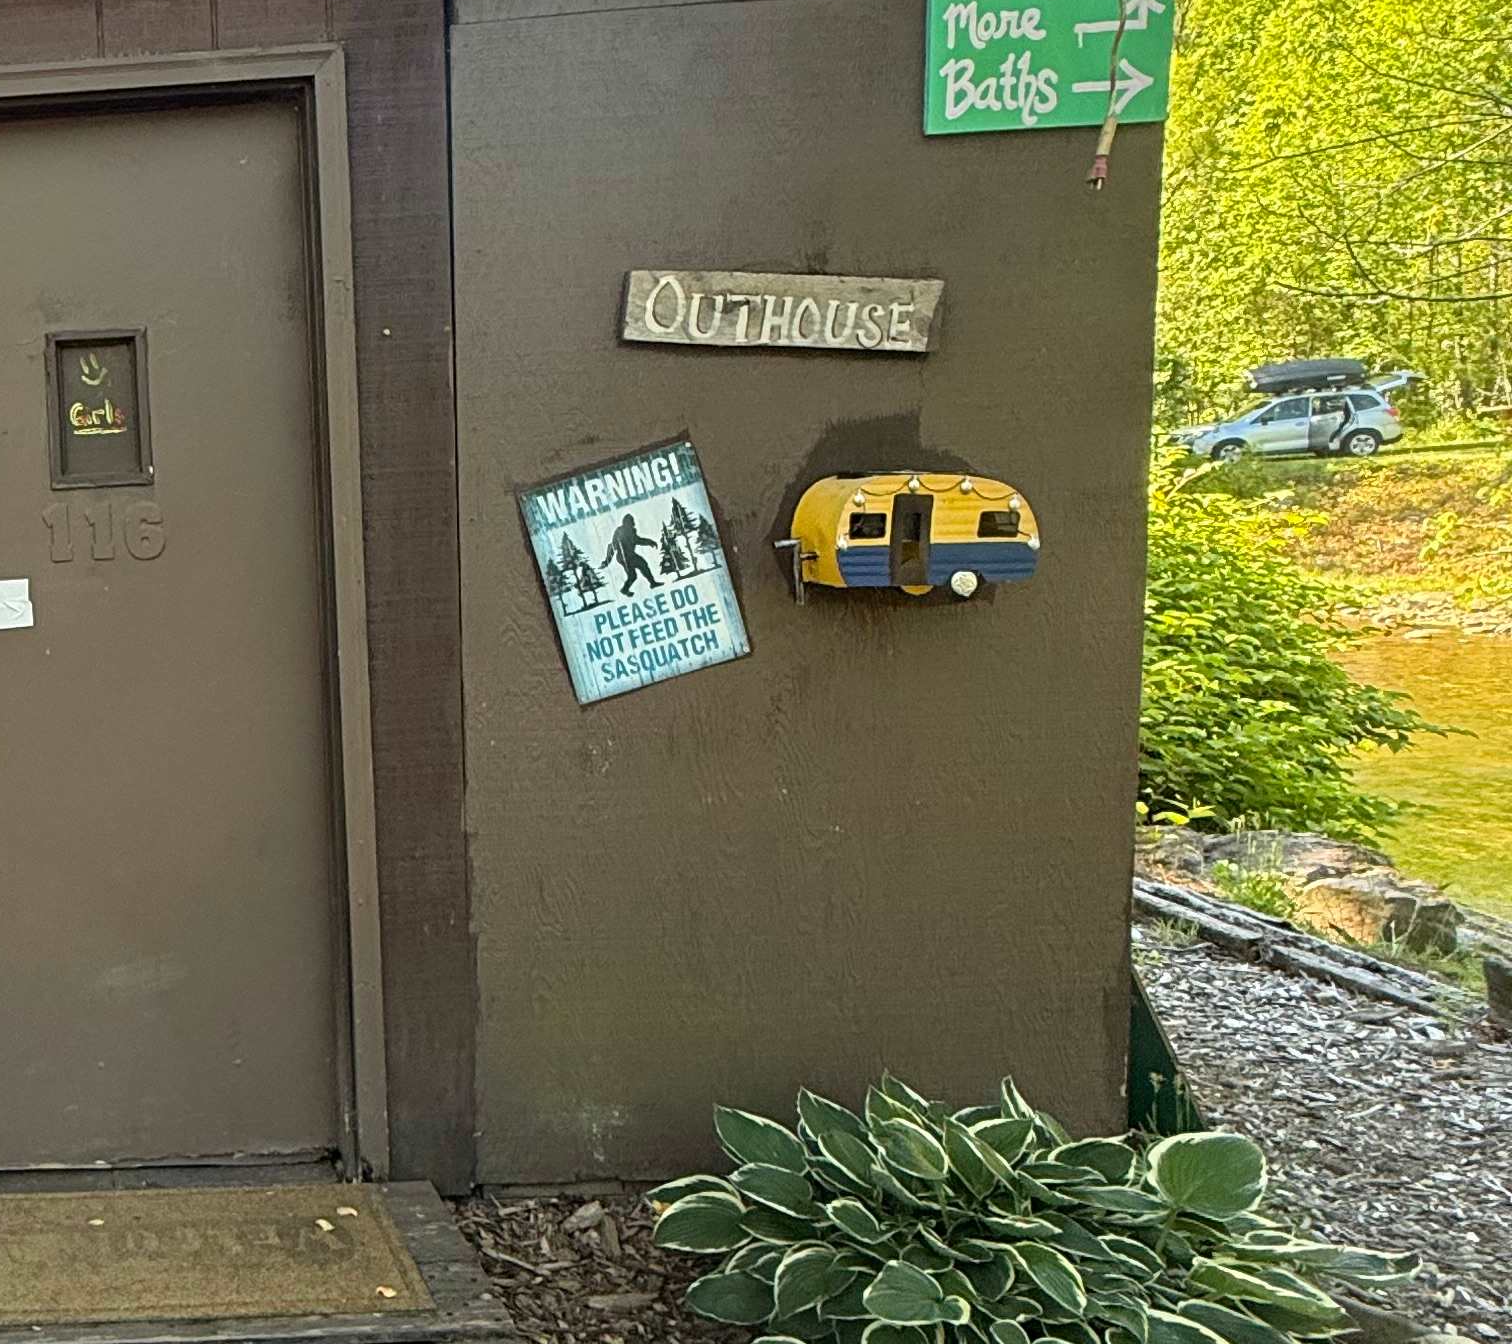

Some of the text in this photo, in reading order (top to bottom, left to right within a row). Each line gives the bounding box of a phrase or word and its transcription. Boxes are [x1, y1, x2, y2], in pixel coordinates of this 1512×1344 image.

[943, 1, 1047, 49] More
[940, 51, 1059, 127] Baths
[644, 275, 914, 348] OUTHOUSE
[537, 452, 683, 524] WARNING!
[42, 501, 167, 564] 116
[586, 603, 721, 662] NOT FEED THE
[594, 584, 699, 634] PLEASE DO
[601, 629, 719, 683] SASQUATCH
